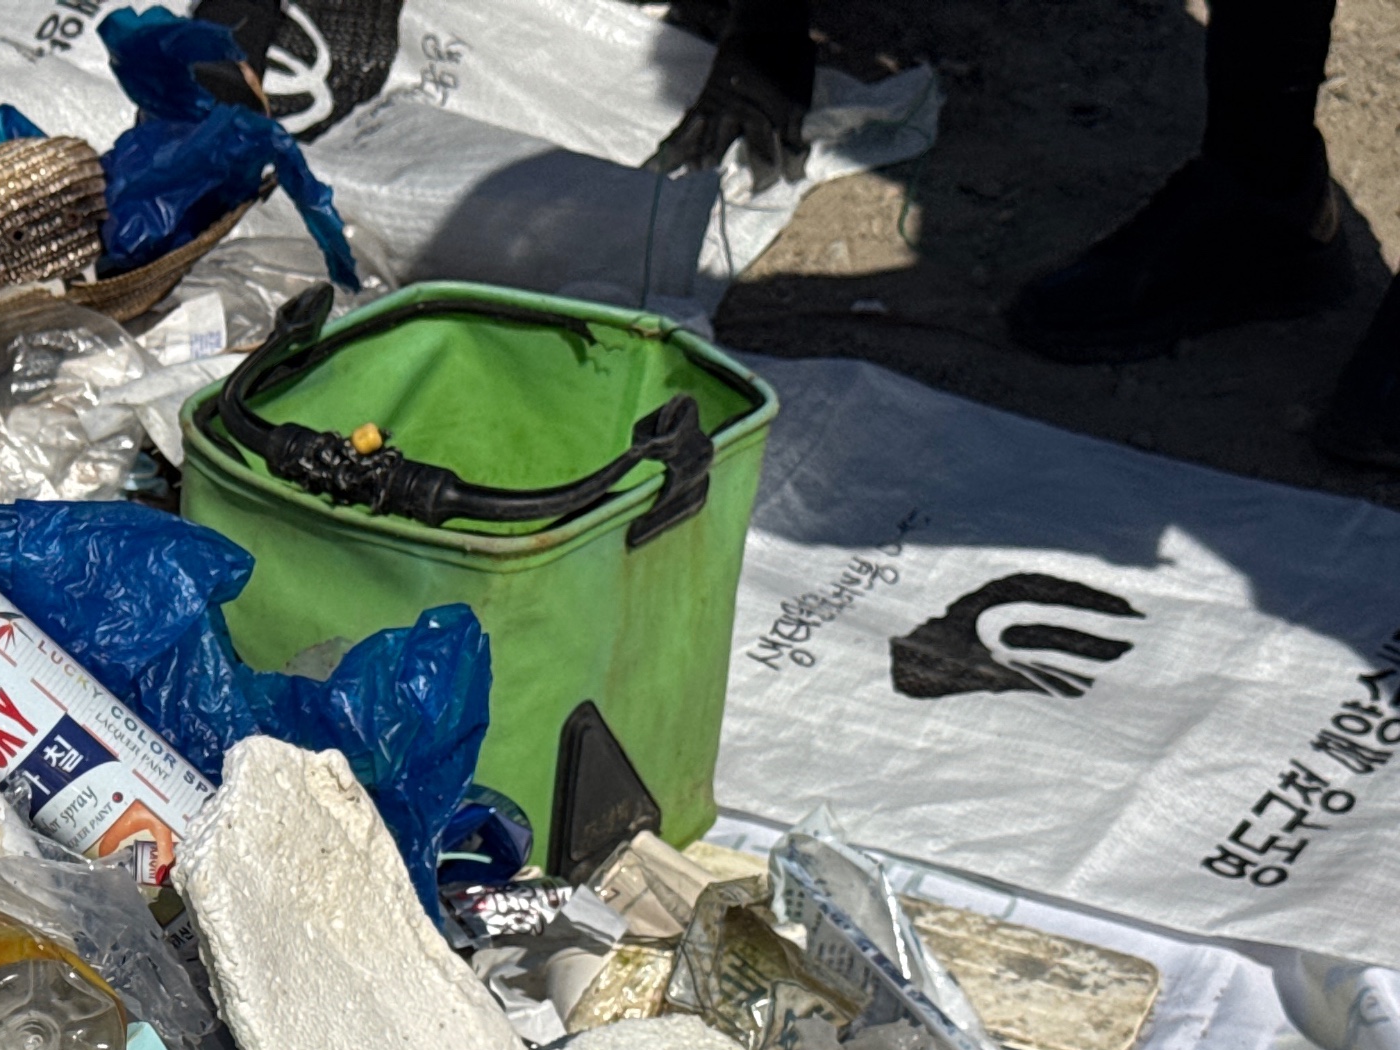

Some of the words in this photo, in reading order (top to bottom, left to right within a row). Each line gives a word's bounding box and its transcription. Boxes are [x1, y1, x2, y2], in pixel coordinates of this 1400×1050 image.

[36, 639, 104, 700] LUCKY
[107, 703, 179, 770] COLOR
[93, 711, 140, 756] LACQUER
[139, 753, 170, 781] PAINT
[56, 784, 101, 827] spray
[87, 802, 114, 829] PAINT
[1202, 762, 1360, 888] 영도구청
